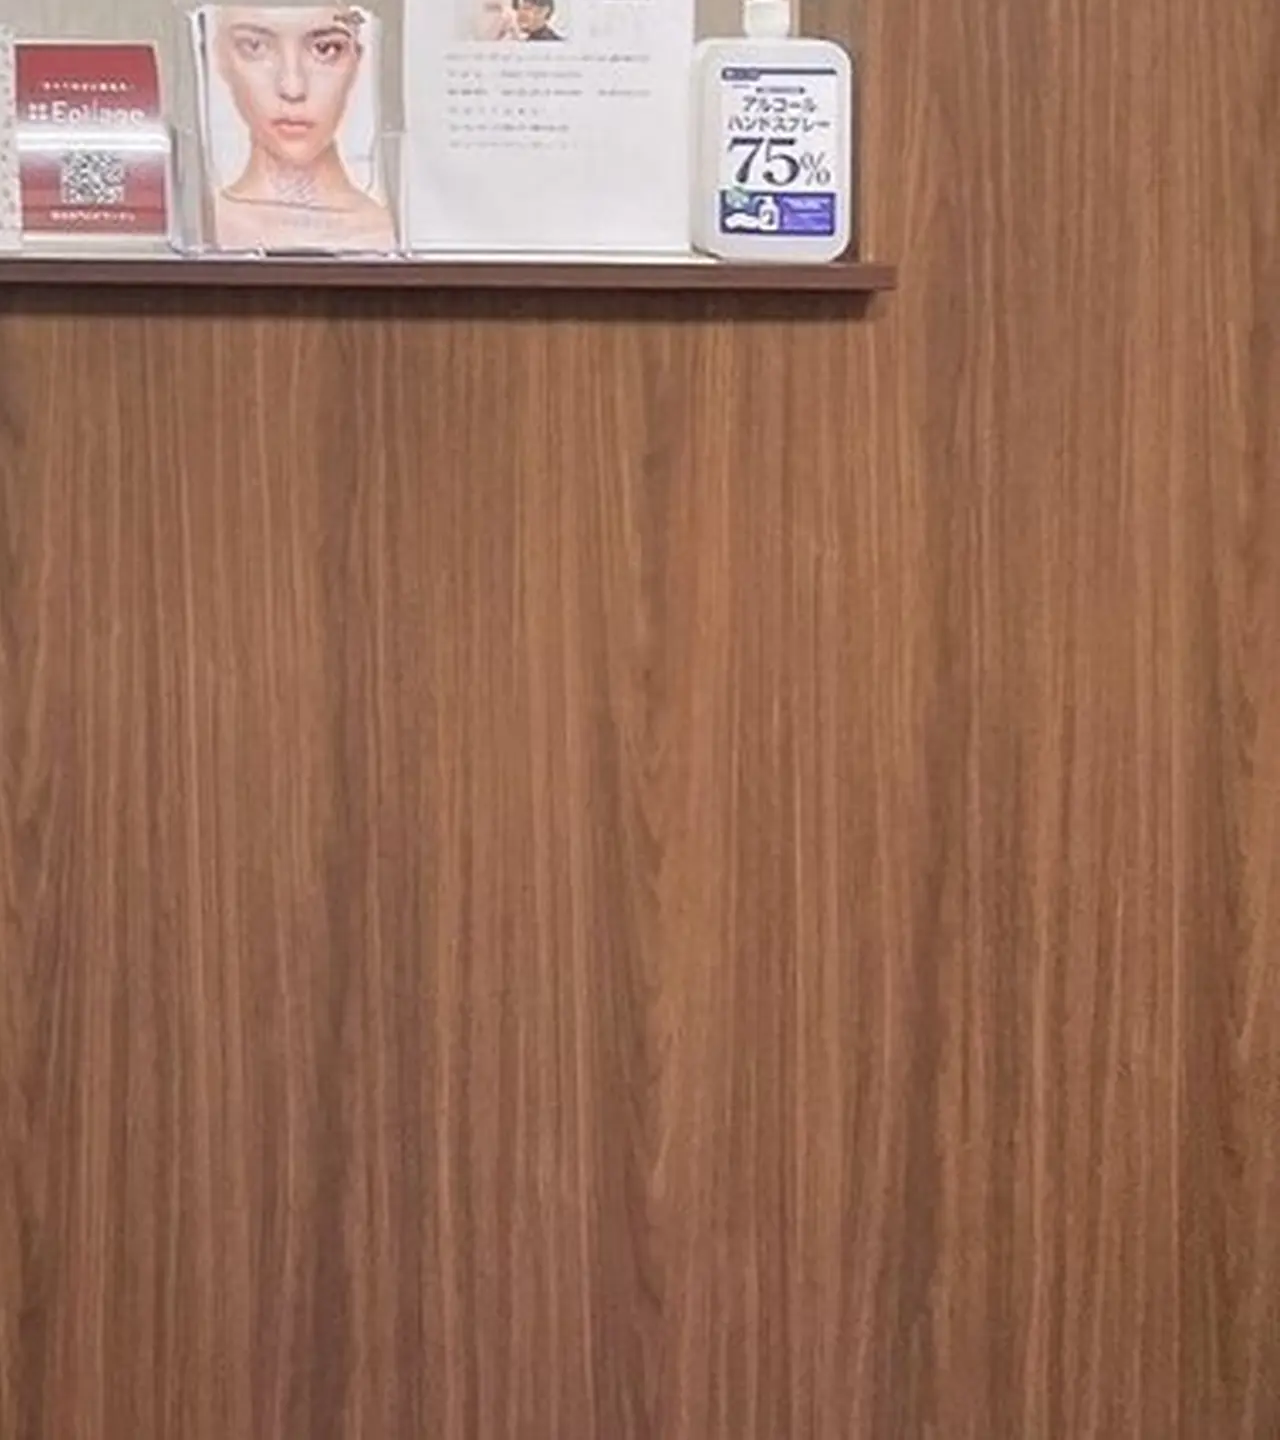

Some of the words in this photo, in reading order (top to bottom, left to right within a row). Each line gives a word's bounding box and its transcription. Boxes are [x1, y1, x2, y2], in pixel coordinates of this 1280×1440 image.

[742, 96, 818, 112] アルコール
[727, 137, 831, 186] 75%
